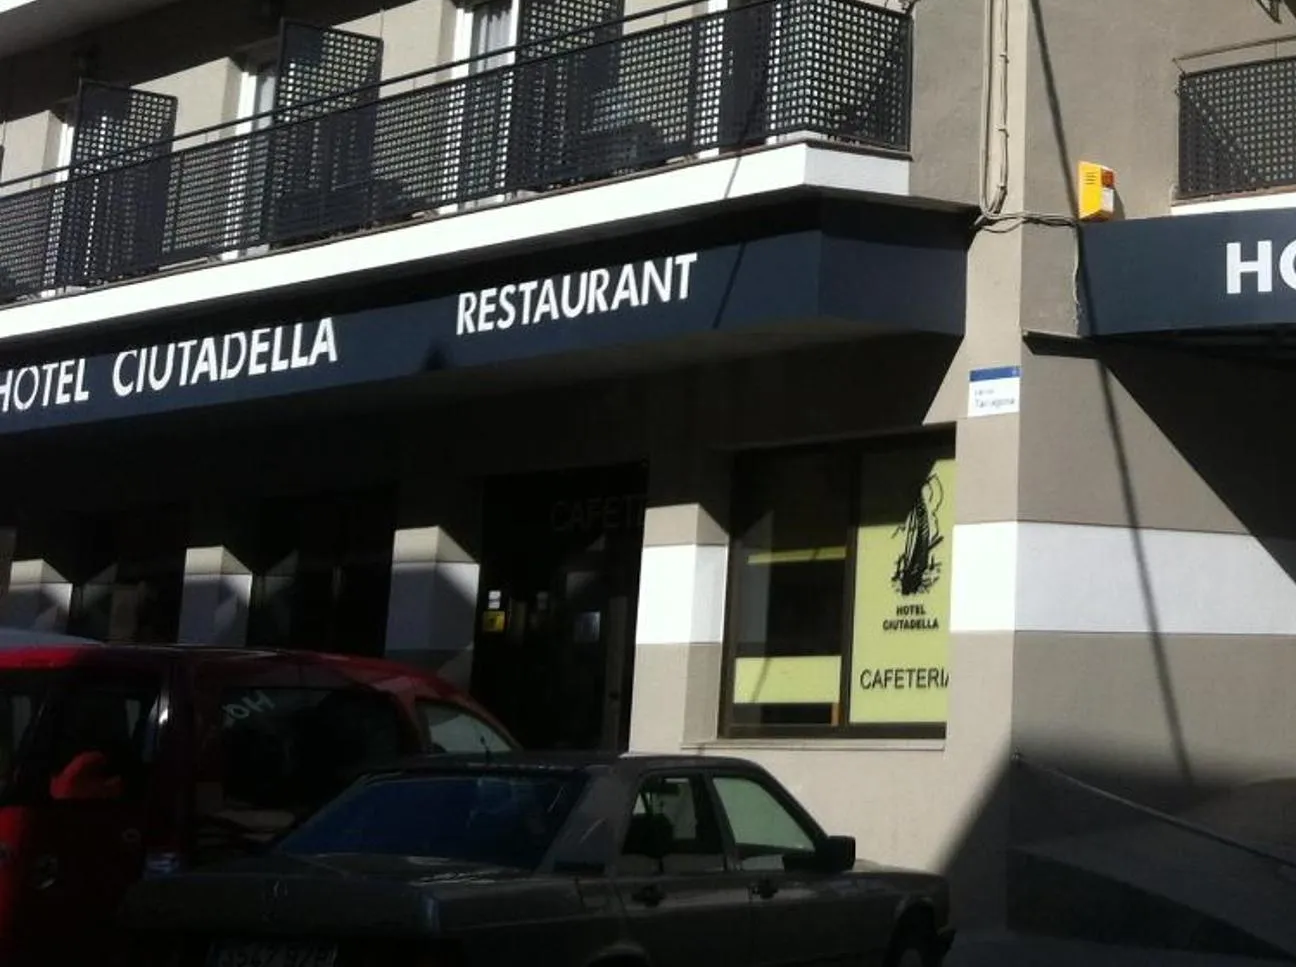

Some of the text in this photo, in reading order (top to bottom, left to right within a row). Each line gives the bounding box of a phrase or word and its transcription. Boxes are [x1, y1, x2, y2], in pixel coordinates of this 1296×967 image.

[456, 252, 698, 336] RESTAURANT
[0, 316, 338, 413] HOTEL CIUTADELLA
[882, 618, 939, 630] CIUTADELLA
[896, 604, 926, 616] HOTEL
